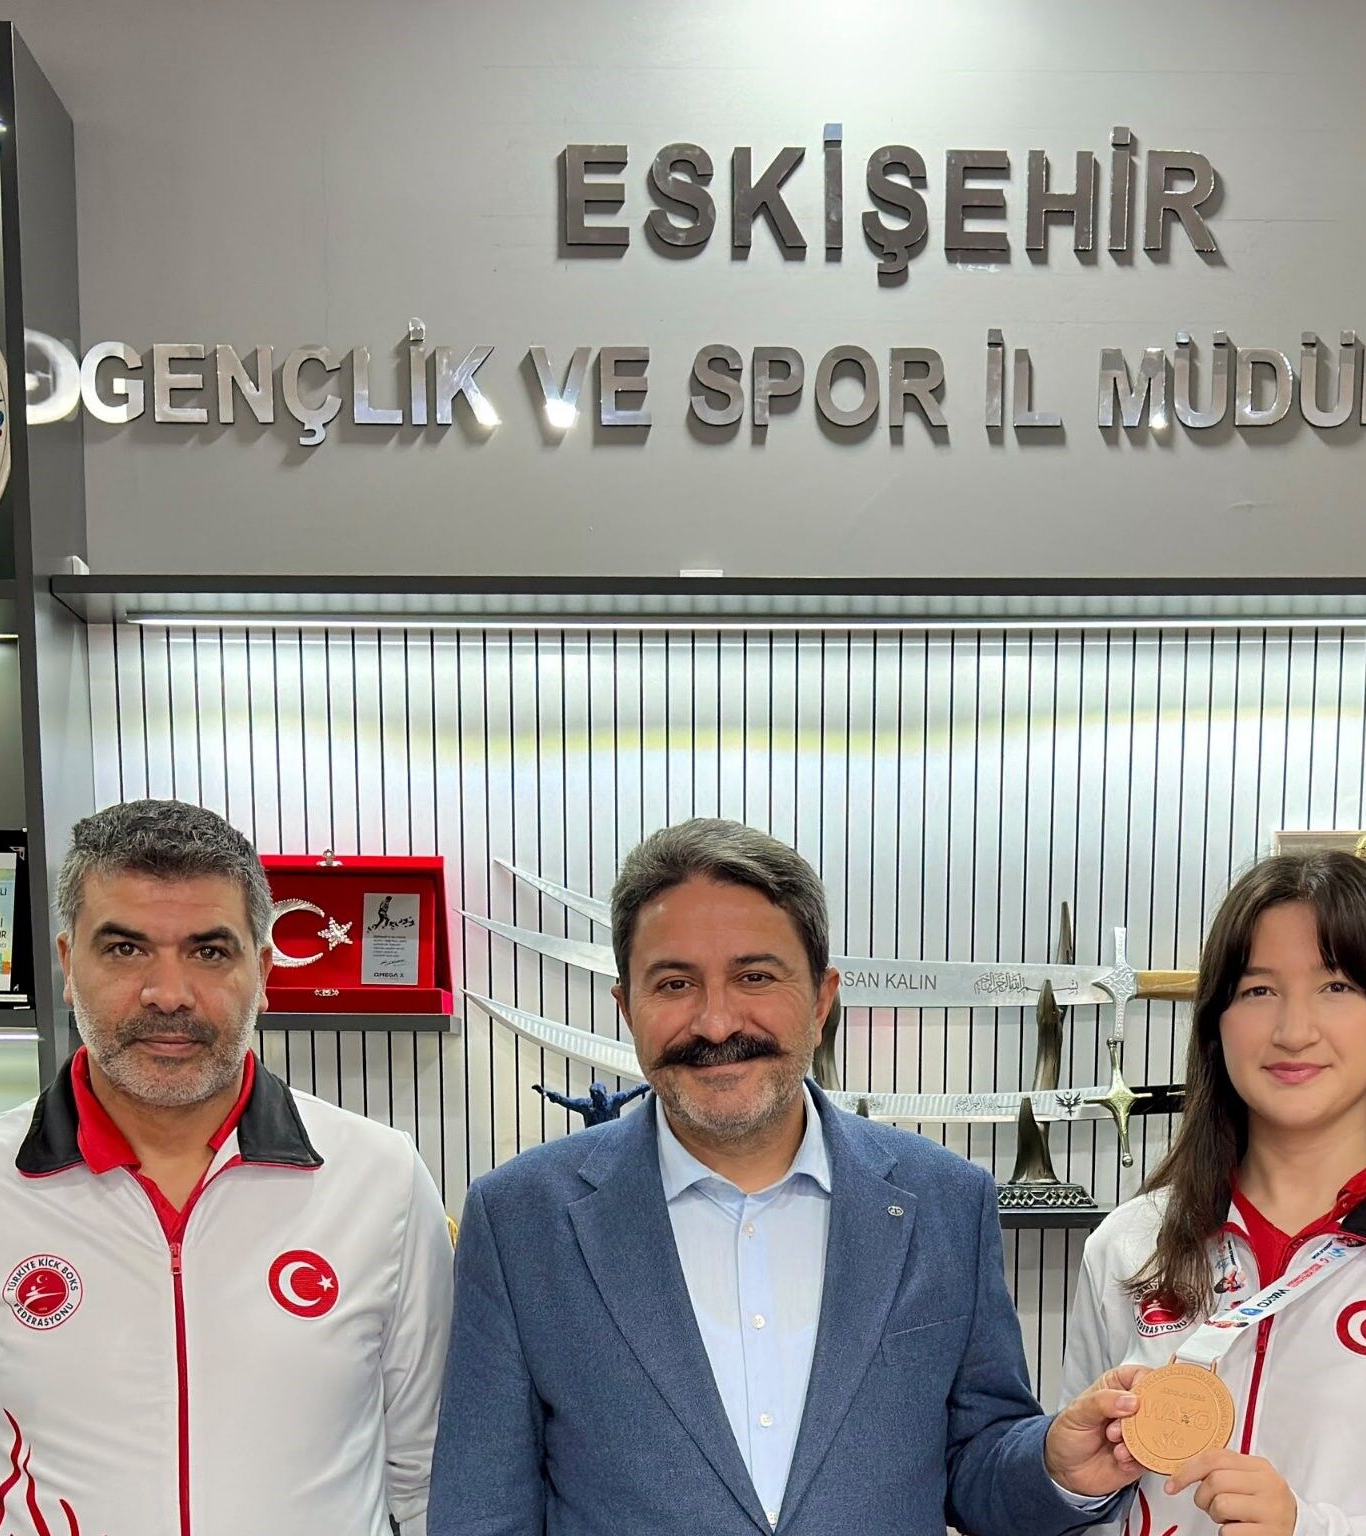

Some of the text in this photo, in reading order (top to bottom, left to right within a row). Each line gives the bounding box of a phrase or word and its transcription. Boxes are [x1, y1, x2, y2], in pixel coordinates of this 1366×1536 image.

[563, 122, 1218, 275] ESKİŞEHİR
[81, 318, 500, 446] GENÇLİK
[529, 345, 652, 427] VE
[690, 343, 948, 427] SPOR
[985, 328, 1063, 427] İL
[885, 972, 937, 990] KALIN
[7, 1257, 79, 1292] TÜRKİYE KİCK BOKS
[13, 1302, 74, 1326] FEDERASYONU
